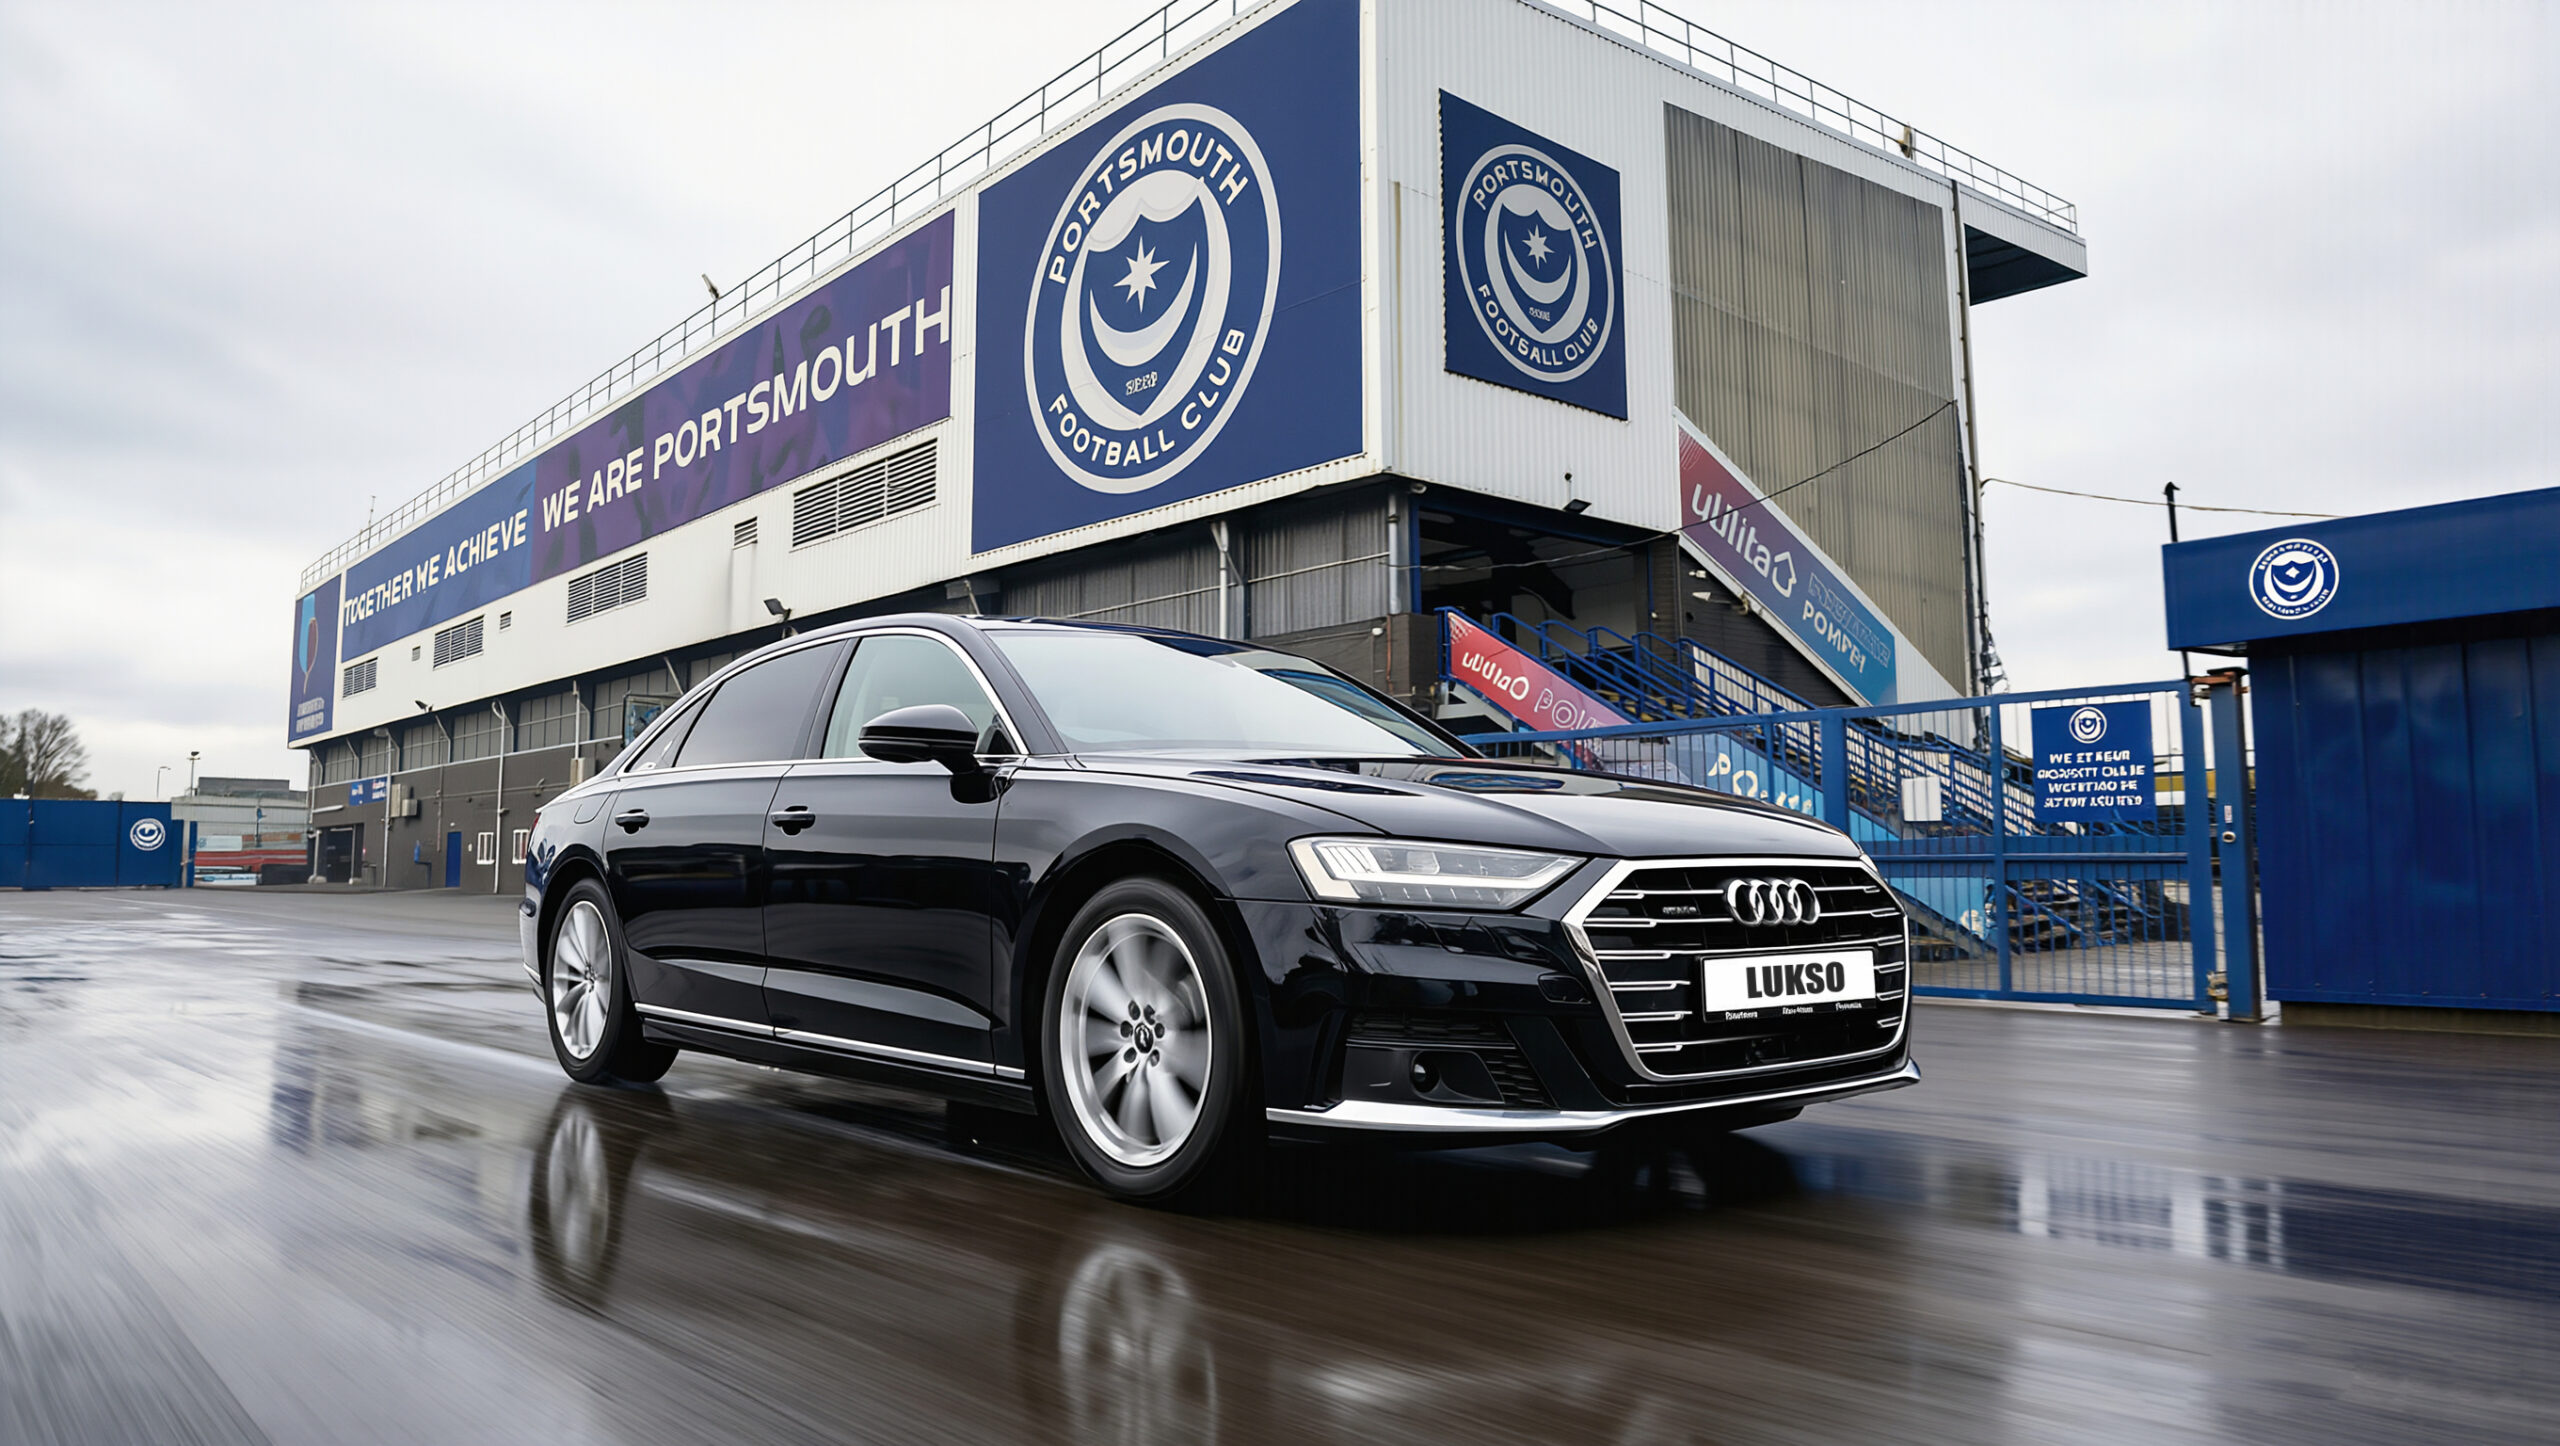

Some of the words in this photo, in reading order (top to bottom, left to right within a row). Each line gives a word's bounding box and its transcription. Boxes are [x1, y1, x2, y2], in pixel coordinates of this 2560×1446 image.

[1048, 129, 1249, 285] PORTSMOUTH
[1472, 160, 1598, 250] PORTSMOUTH
[1477, 284, 1563, 366] FOOTBALL
[542, 480, 581, 533] WE
[586, 446, 644, 514] ARE
[654, 285, 951, 480] PORTSMOUTH
[1048, 393, 1176, 467] FOOTBALL
[1181, 328, 1246, 430] CLUB
[344, 568, 414, 628] TOGETHER
[416, 553, 441, 594] WE
[444, 508, 528, 580] ACHIEVE
[1746, 961, 1846, 1000] LUKSO
